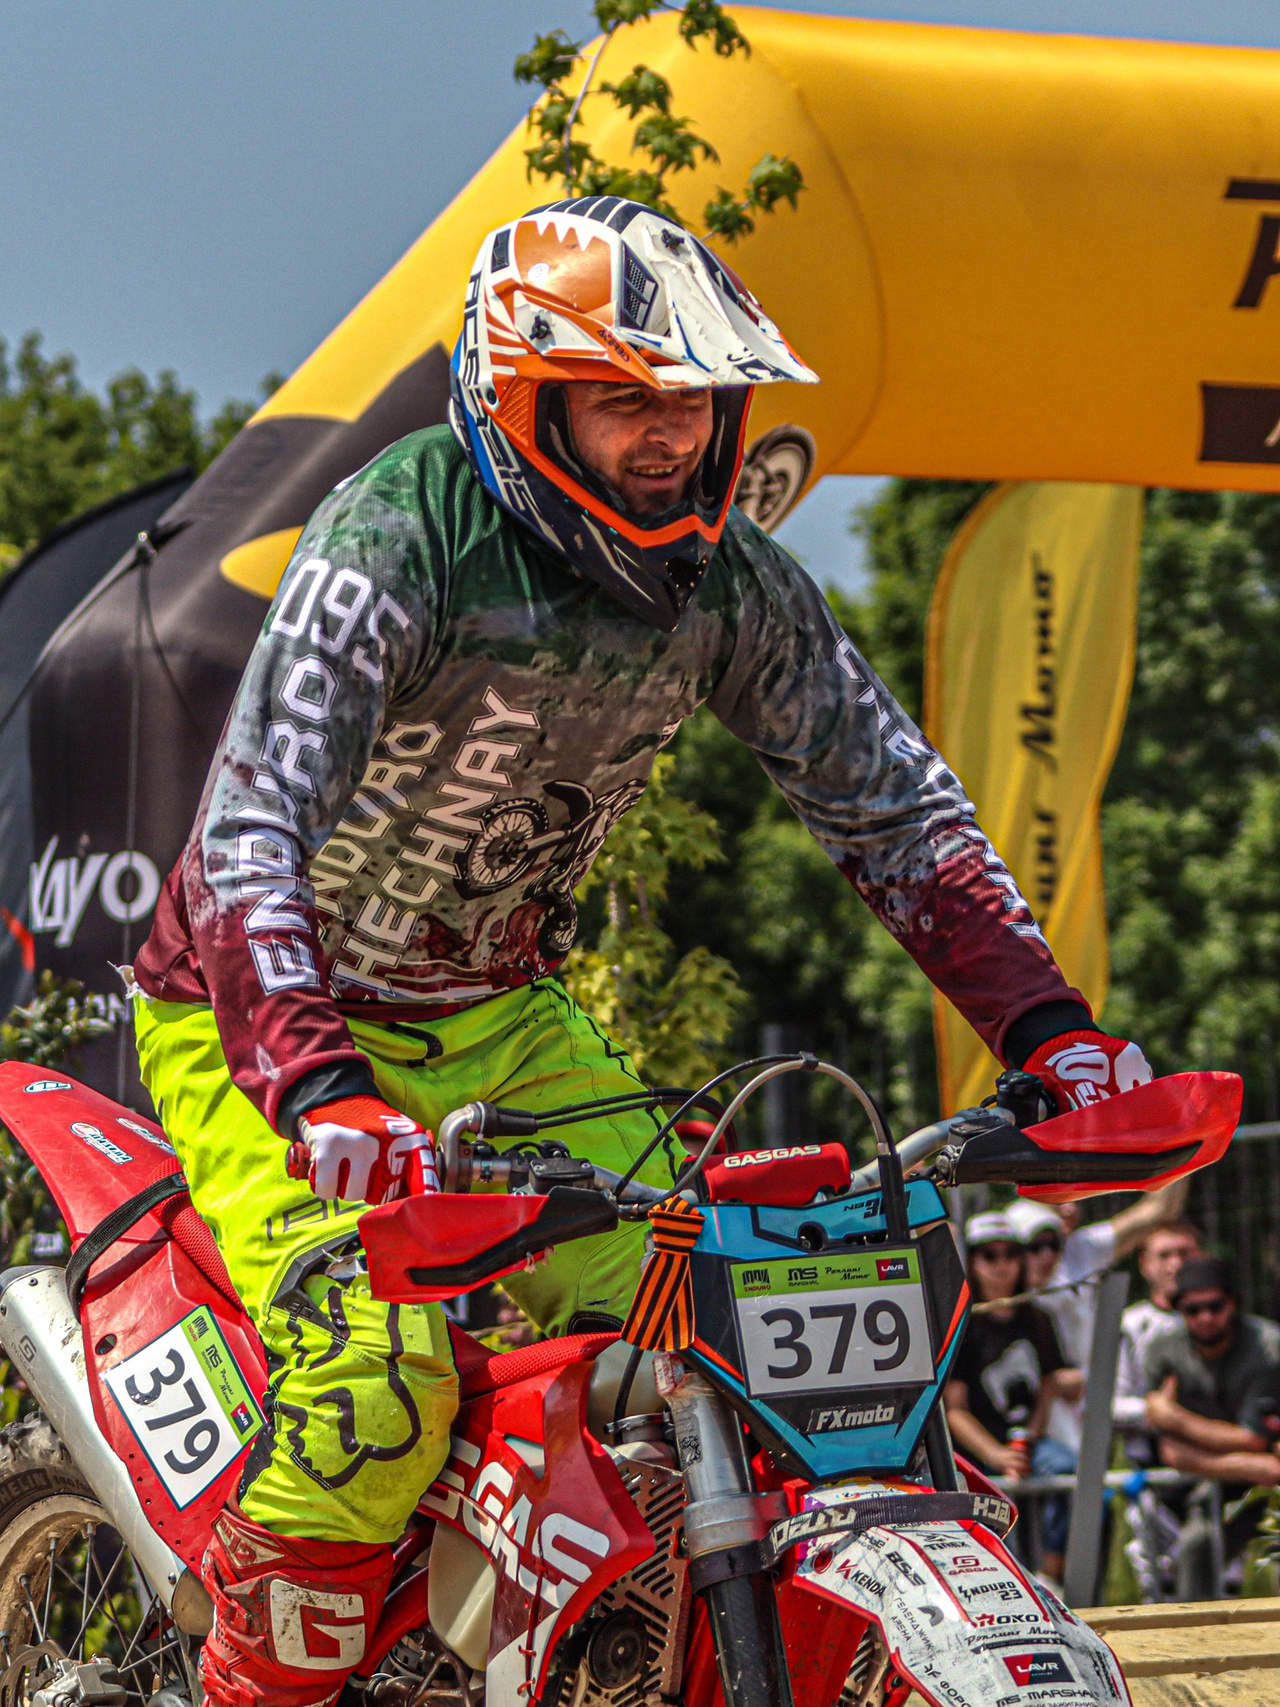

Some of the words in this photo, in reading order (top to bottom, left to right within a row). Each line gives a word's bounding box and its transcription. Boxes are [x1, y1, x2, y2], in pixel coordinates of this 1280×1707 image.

[230, 653, 341, 996] ENDURO
[320, 719, 445, 942] NDURO
[329, 686, 540, 998] HECHNAY
[724, 1145, 821, 1168] GASGAS
[881, 1264, 904, 1272] LAVR
[745, 1284, 771, 1292] ENDURO
[760, 1299, 910, 1379] 379
[124, 1348, 220, 1475] 379
[816, 1404, 894, 1430] FXmoto
[851, 1570, 887, 1597] KENDA
[948, 1567, 999, 1576] GASGAS
[998, 1589, 1023, 1601] 23
[891, 1615, 912, 1641] АРЕНА
[894, 1597, 935, 1651] ГЕЛЕНДЖИК
[1017, 1662, 1059, 1673] LAVR
